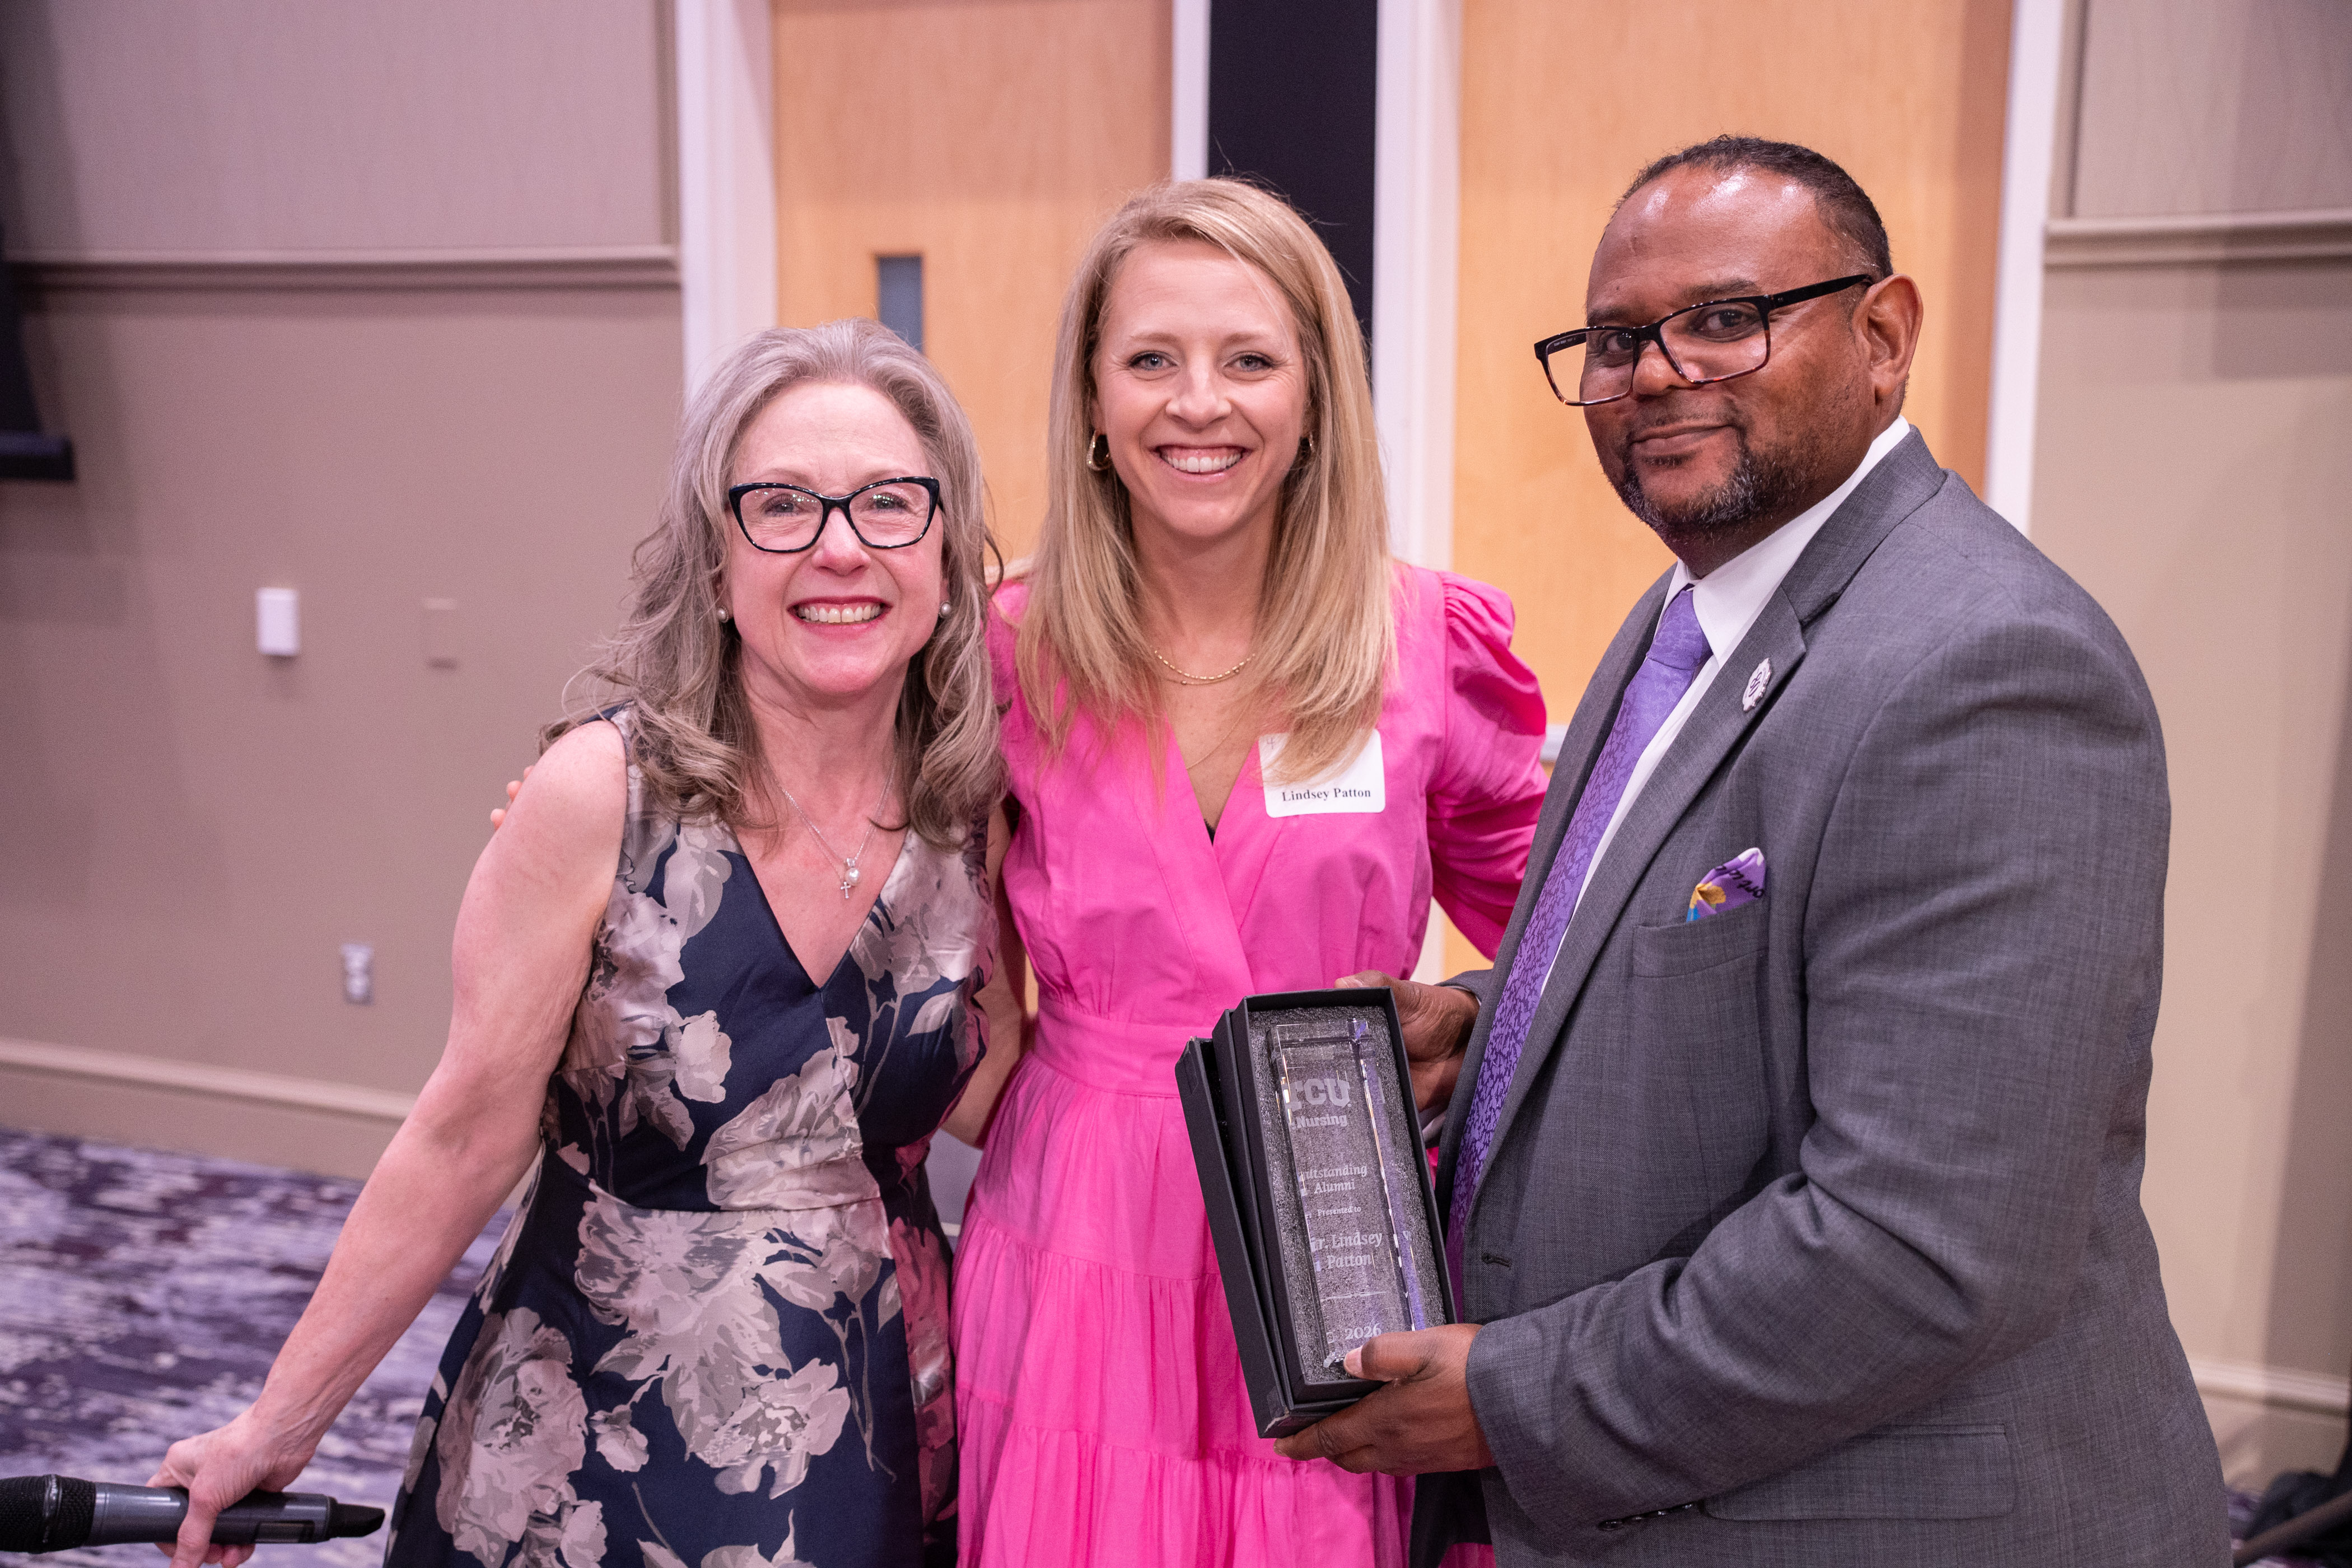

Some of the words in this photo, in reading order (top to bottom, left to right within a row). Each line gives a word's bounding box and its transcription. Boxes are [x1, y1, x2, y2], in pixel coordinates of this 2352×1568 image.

[1282, 789, 1329, 802] Lindsey
[1333, 787, 1371, 799] Patton
[1296, 1113, 1348, 1130] Nursing
[1314, 1178, 1356, 1194] Alumni
[1317, 1206, 1354, 1216] Presented
[1331, 1232, 1383, 1249] Lindsey
[1327, 1254, 1373, 1270] Patton
[1345, 1323, 1382, 1340] 2026
